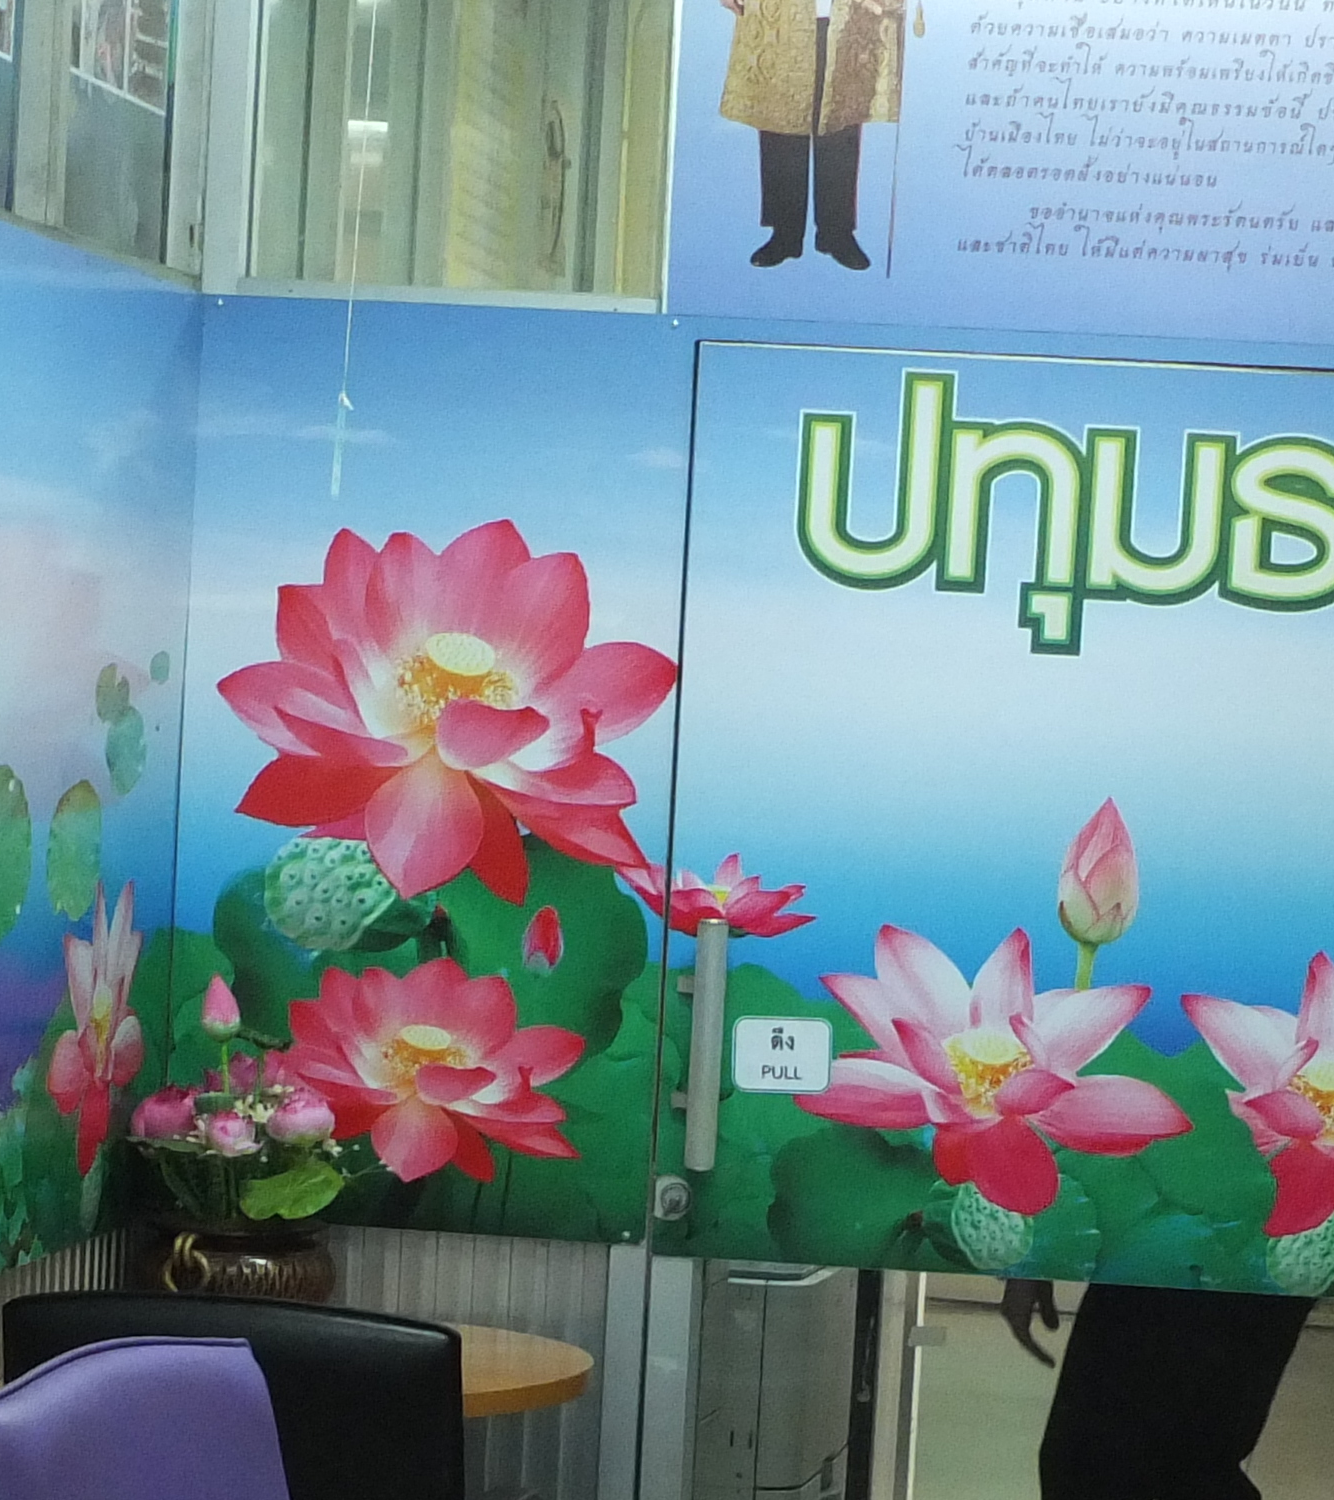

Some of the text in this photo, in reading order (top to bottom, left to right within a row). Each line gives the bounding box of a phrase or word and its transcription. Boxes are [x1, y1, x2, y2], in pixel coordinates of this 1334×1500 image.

[1180, 28, 1292, 47] ความเมตตา
[771, 1028, 795, 1051] ดึง
[761, 1065, 802, 1080] PULL
